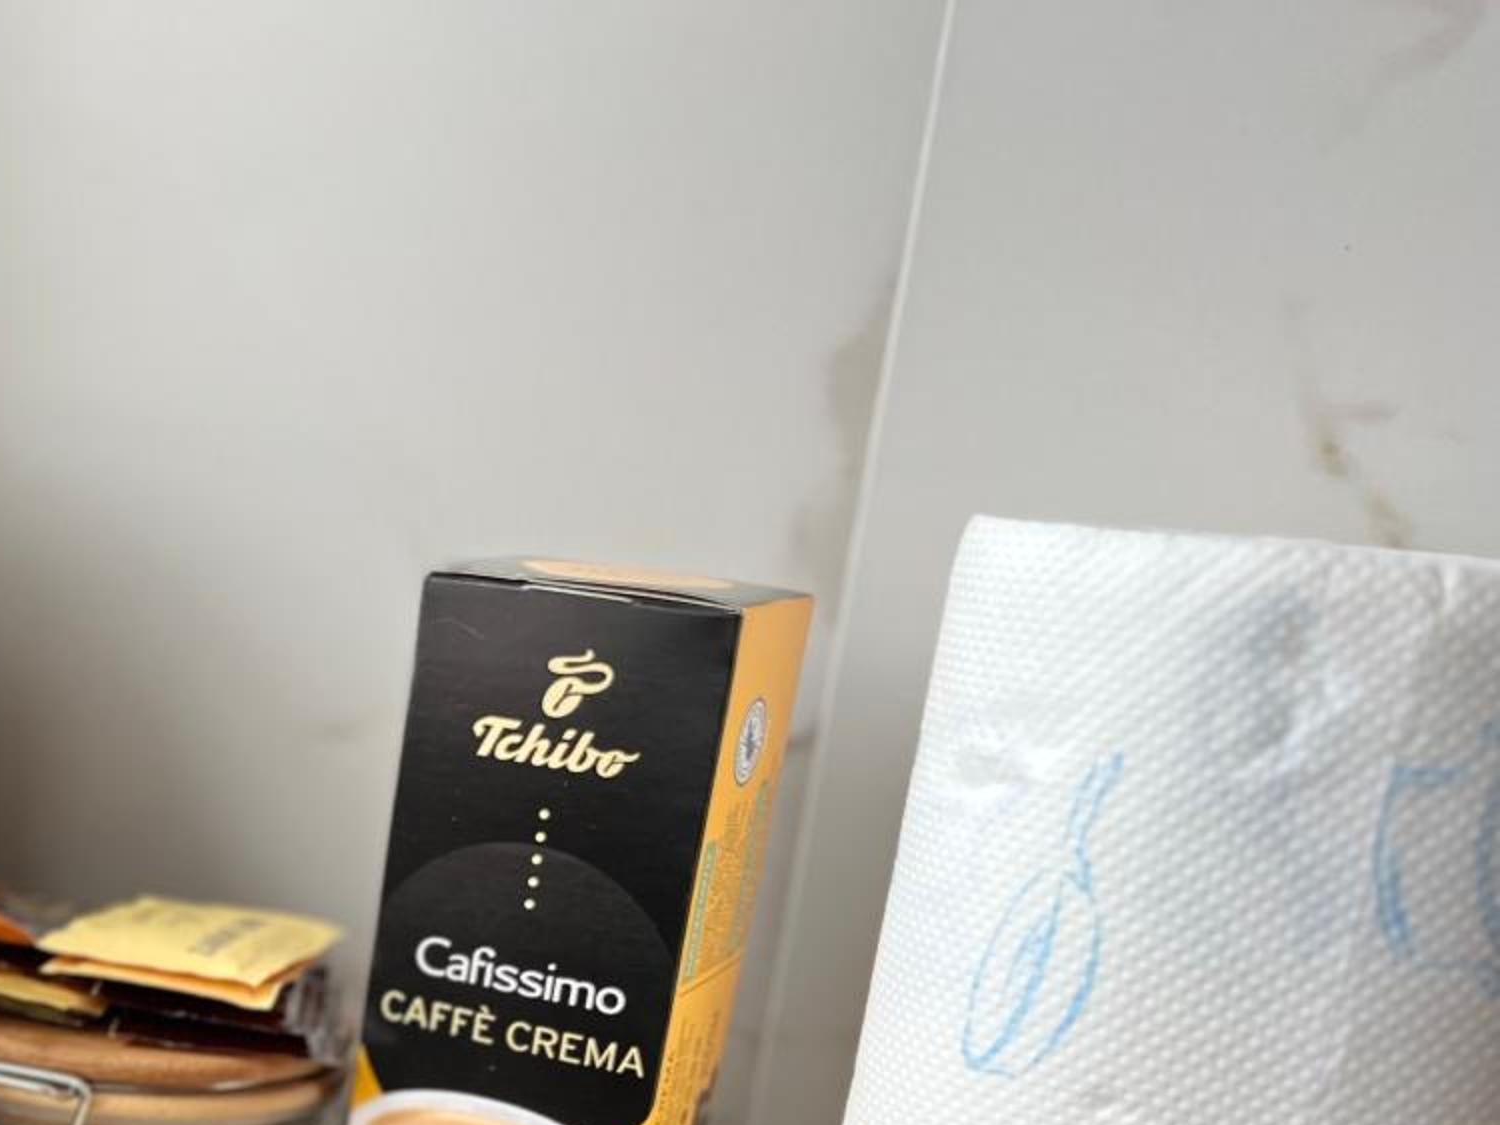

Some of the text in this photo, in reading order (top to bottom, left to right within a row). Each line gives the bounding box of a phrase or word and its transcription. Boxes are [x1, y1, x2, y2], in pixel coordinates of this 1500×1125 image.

[472, 715, 640, 779] Tchibo
[415, 936, 627, 1015] Cafissimo
[380, 990, 645, 1078] CAFFÈ CREMA
